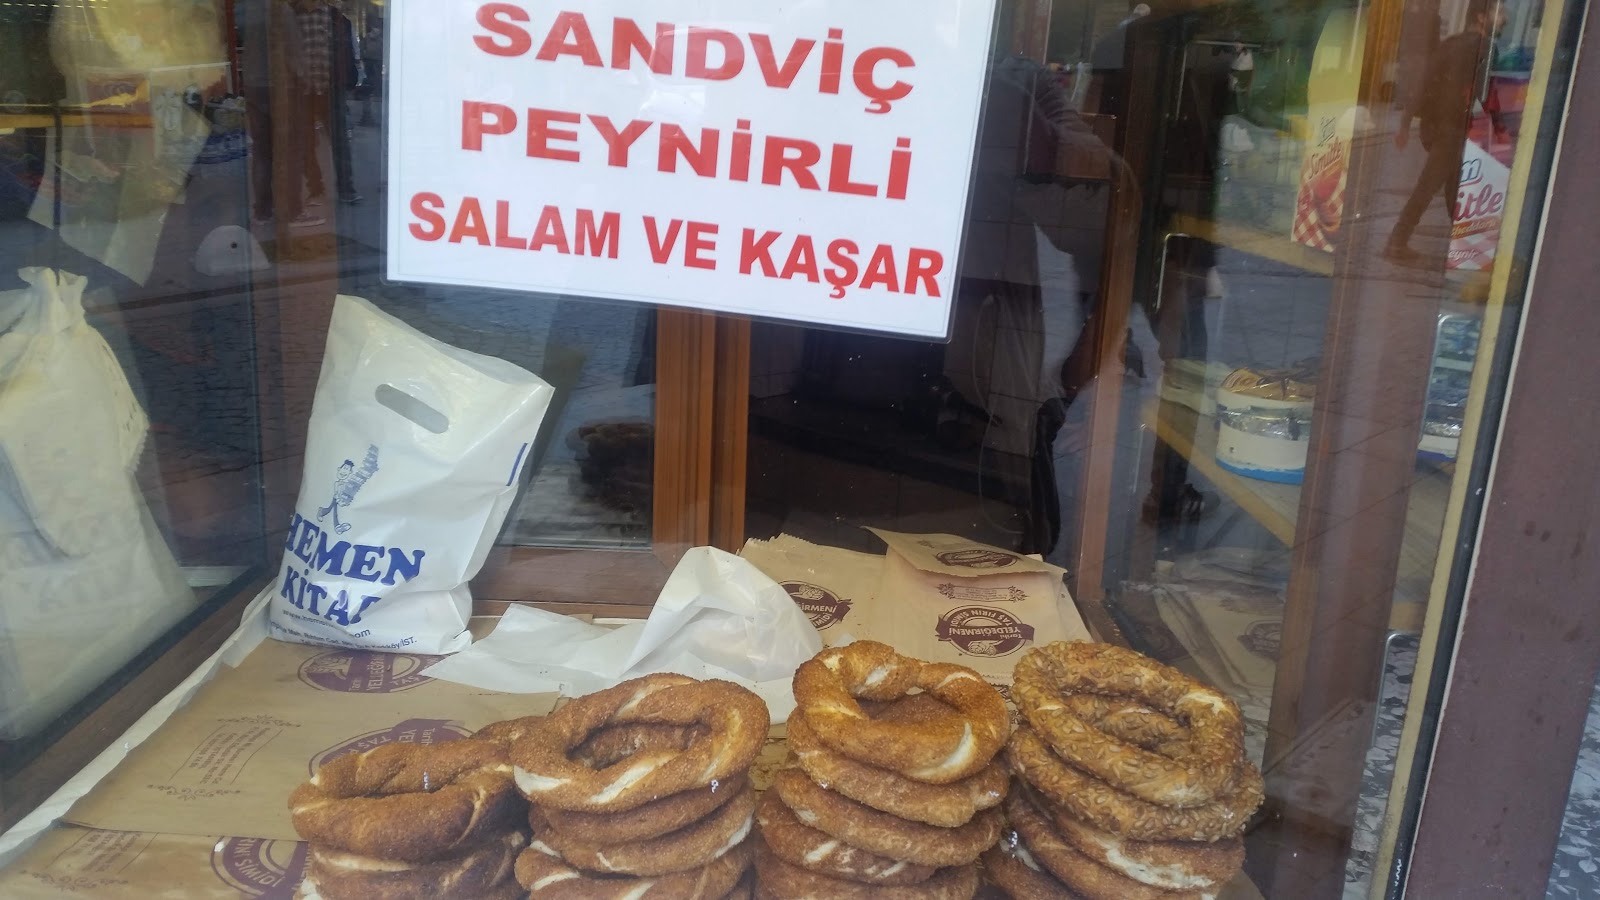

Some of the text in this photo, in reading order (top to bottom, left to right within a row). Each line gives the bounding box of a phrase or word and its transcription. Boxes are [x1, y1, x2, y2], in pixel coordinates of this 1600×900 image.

[473, 3, 915, 114] SANDVİÇ
[461, 101, 912, 200] PEYNİRLİ
[1453, 184, 1503, 221] itle
[408, 192, 944, 299] SALAM VE KAŞAR
[1448, 248, 1479, 262] eynir
[799, 603, 838, 614] İRMENİ
[970, 608, 998, 619] FIRIN
[997, 613, 1014, 627] TAŞ
[948, 626, 1022, 637] YELDEĞİRMENİ
[357, 735, 391, 750] TAŞ
[421, 727, 436, 745] Tarih
[234, 858, 286, 888] SİMİDİ
